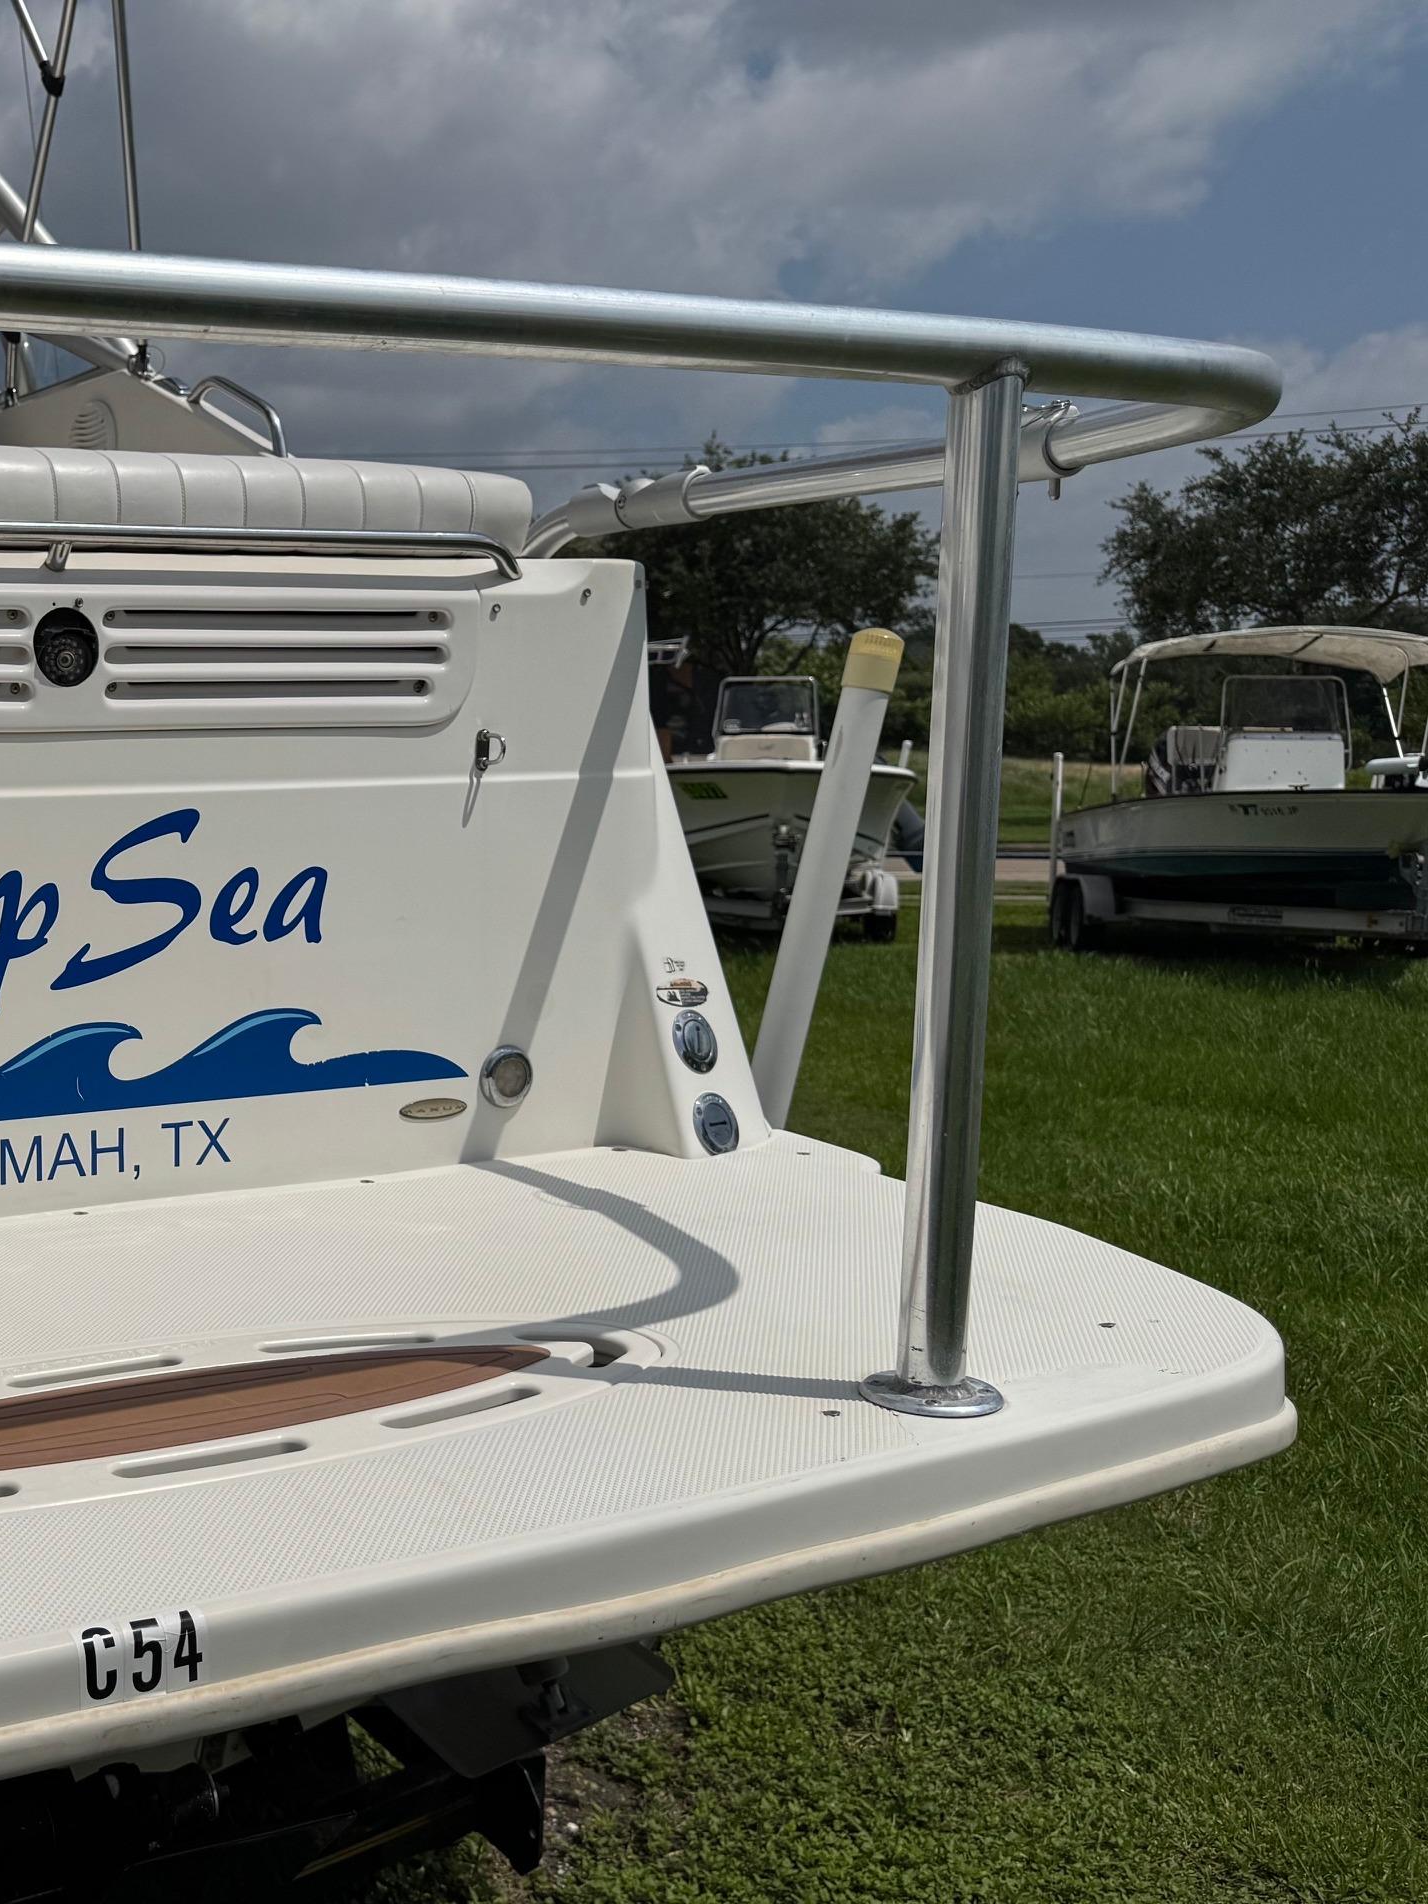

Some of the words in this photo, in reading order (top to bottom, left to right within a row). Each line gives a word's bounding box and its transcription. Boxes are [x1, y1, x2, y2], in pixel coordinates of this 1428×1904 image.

[51, 808, 328, 991] Sea
[161, 1118, 232, 1168] TX
[403, 1104, 464, 1114] MAXUM
[81, 1609, 203, 1701] C54
